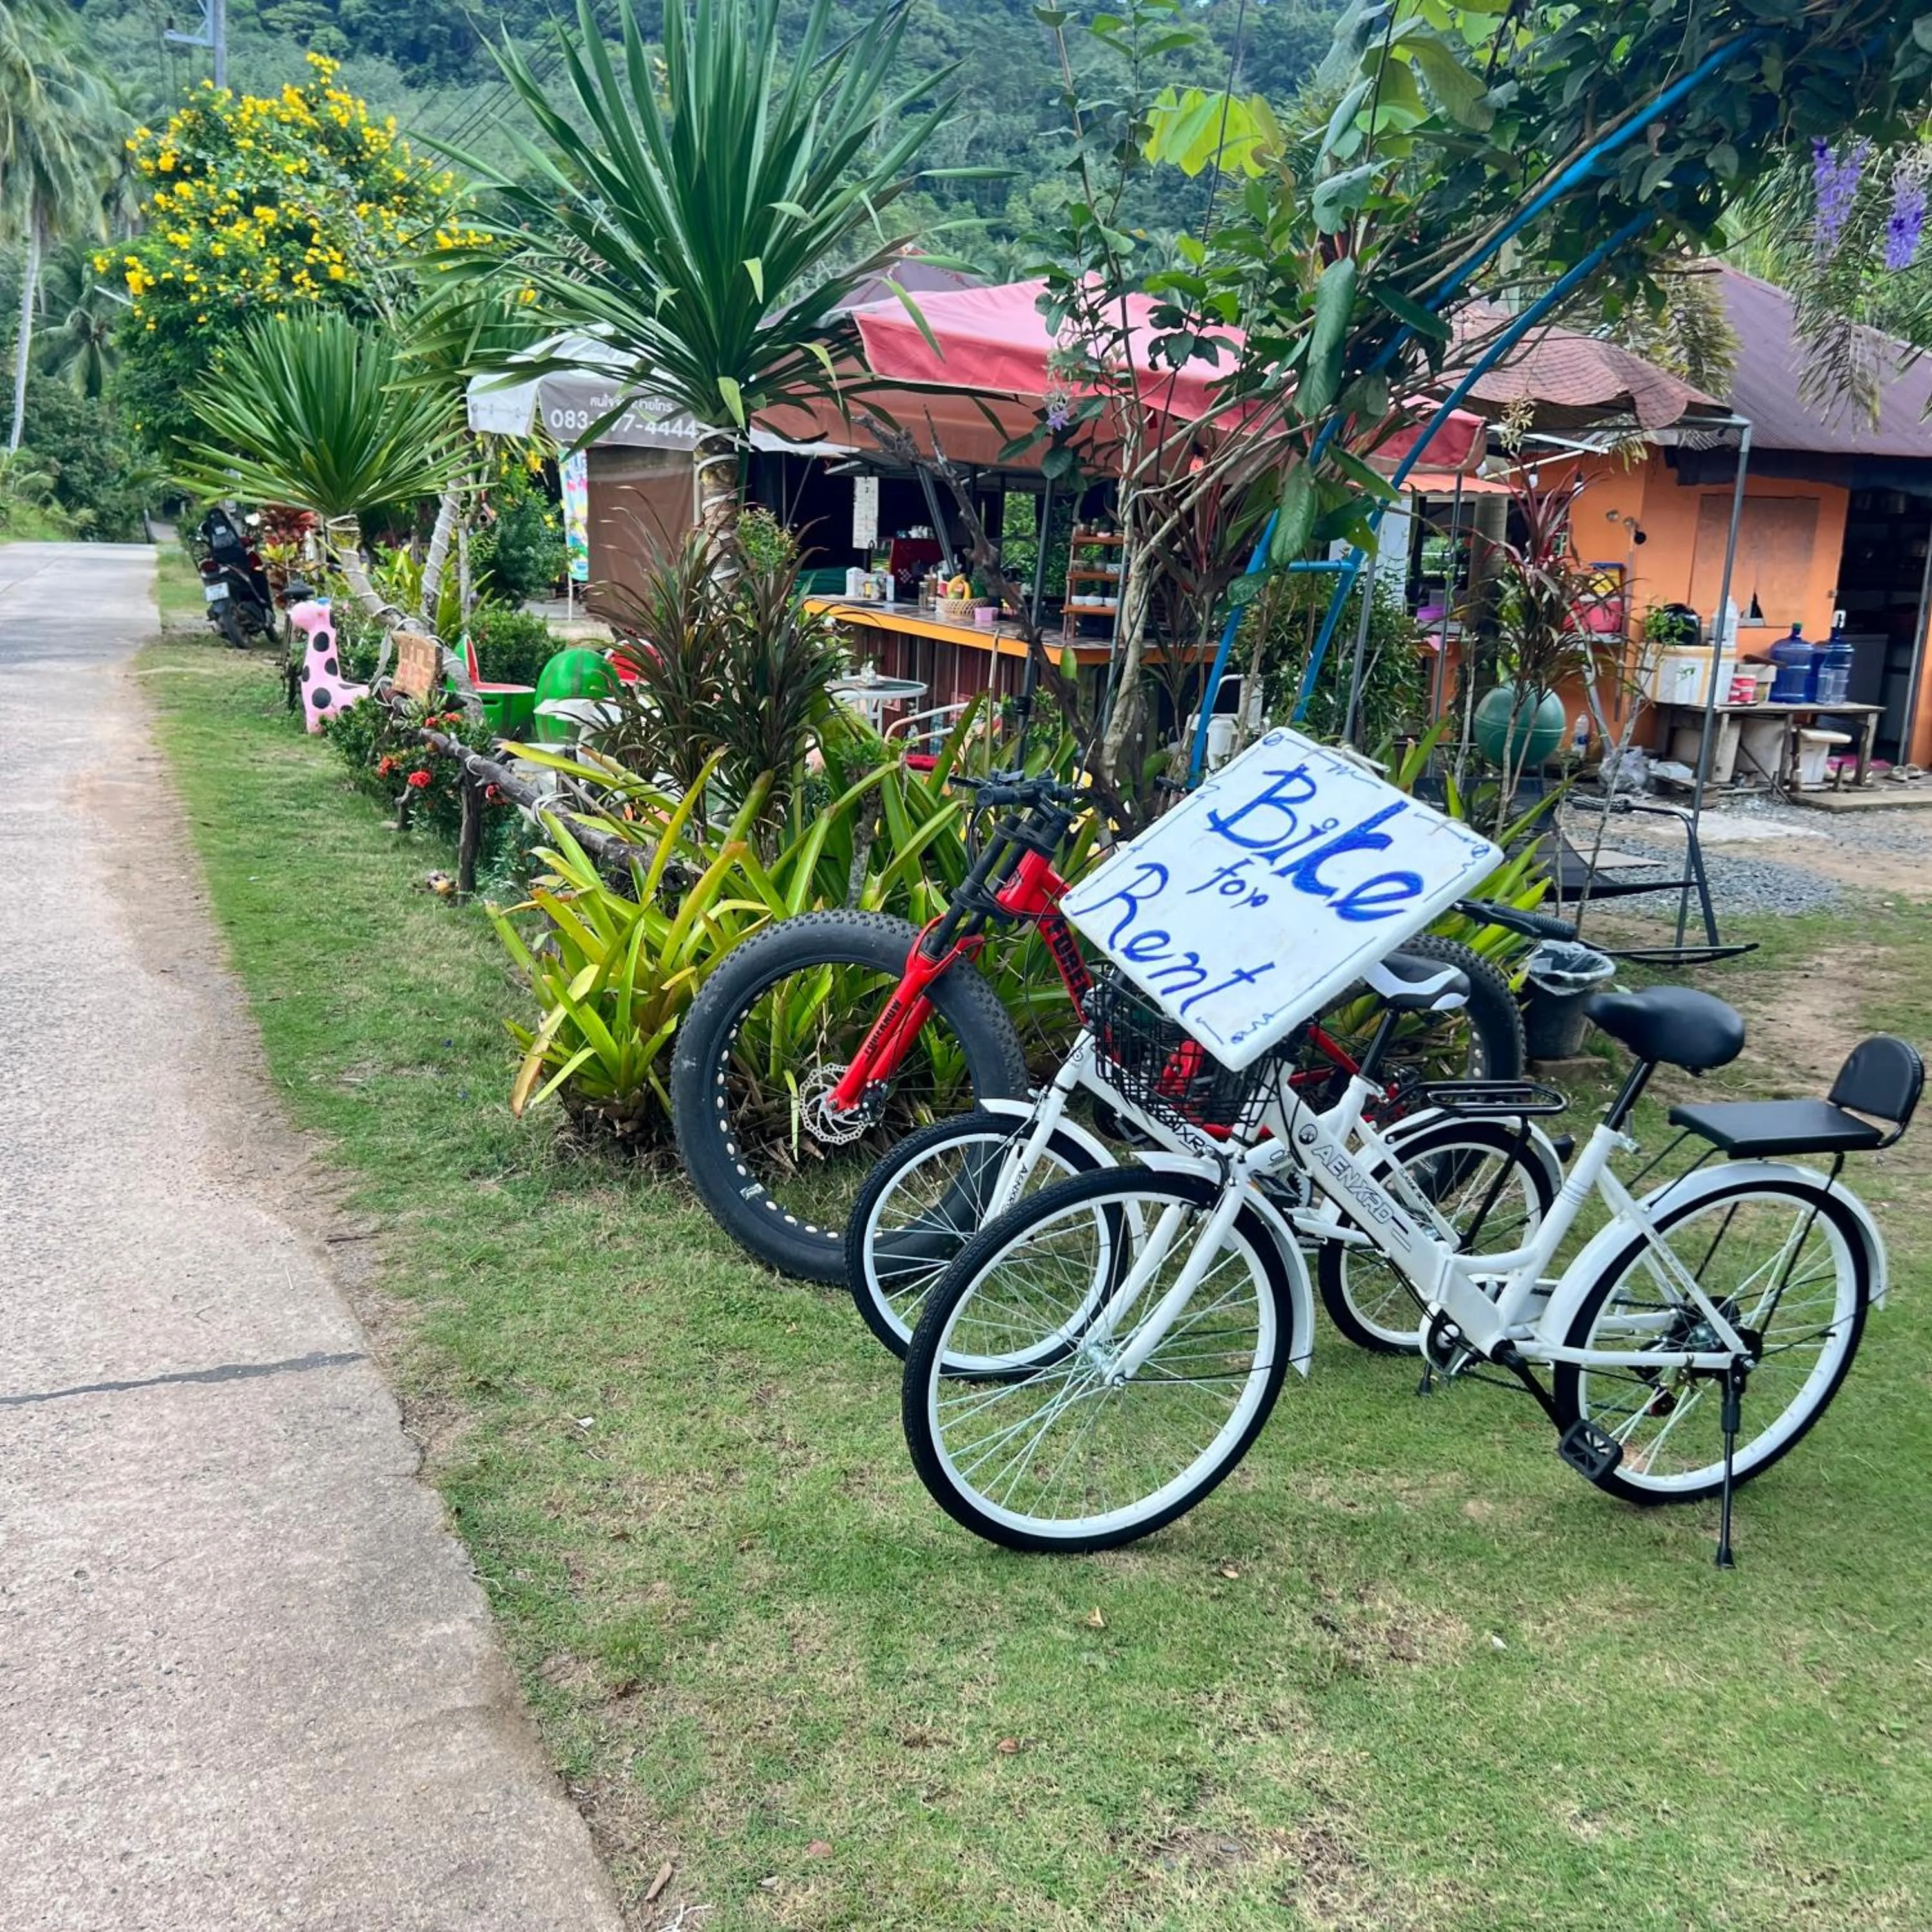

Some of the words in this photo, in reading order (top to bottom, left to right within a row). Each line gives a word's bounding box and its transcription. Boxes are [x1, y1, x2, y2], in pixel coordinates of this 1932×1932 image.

[550, 410, 696, 438] 083-77-4444
[1186, 857, 1269, 908] for
[1207, 764, 1423, 922] Bike
[1072, 862, 1275, 1018] Rent
[1311, 1144, 1394, 1224] AENXRD
